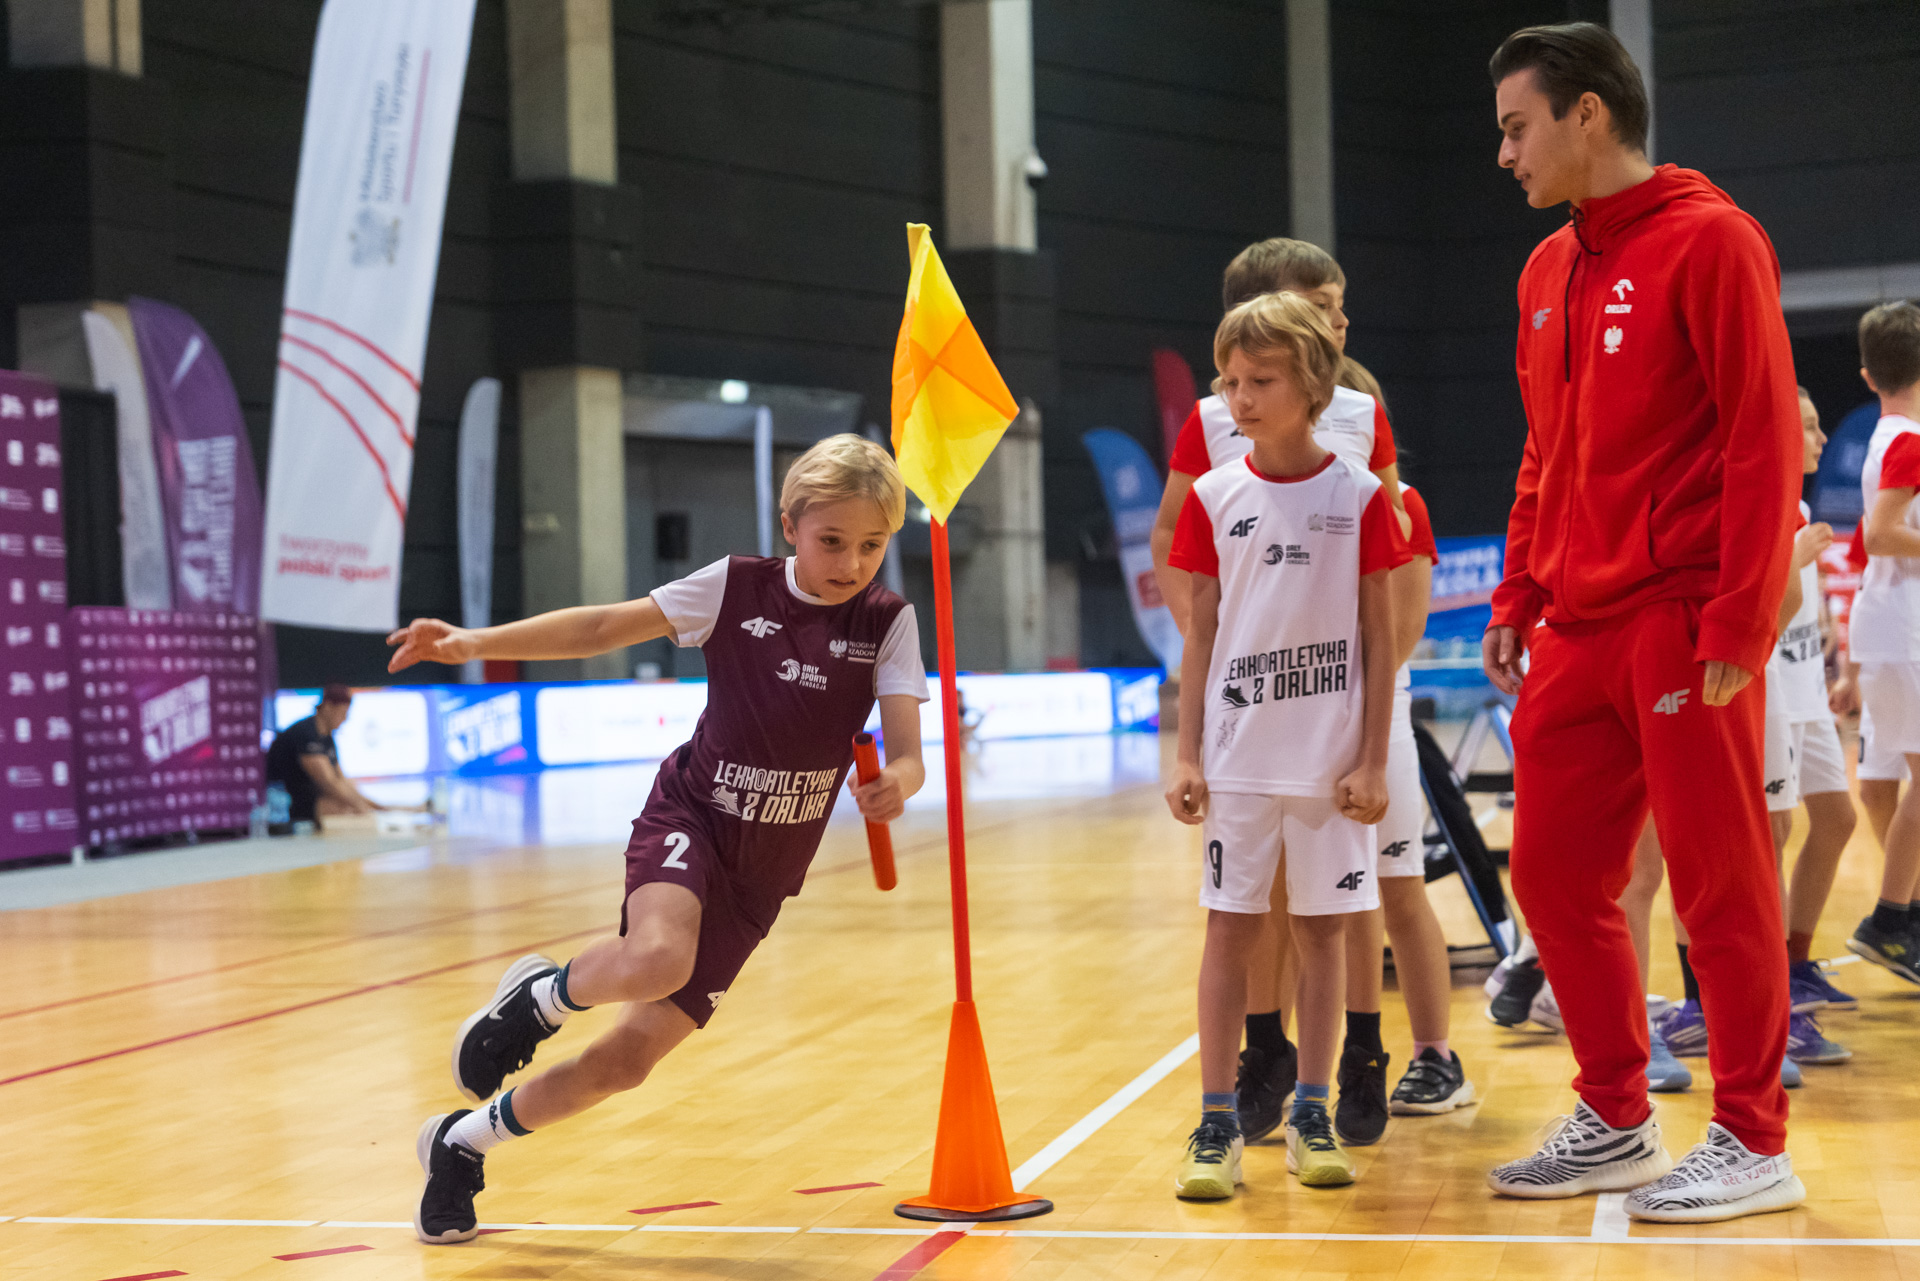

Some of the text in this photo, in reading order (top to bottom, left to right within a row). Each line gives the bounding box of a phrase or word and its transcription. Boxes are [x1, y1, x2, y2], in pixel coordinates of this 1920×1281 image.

[1229, 516, 1259, 537] 4F
[740, 616, 783, 639] 4F
[801, 672, 828, 685] SPORTU
[802, 664, 820, 674] ORŁY
[799, 680, 827, 691] FUNDACJA
[1274, 663, 1348, 701] ORLIKA
[1653, 688, 1690, 715] 4F
[713, 760, 839, 795] LEKKOATLETYKA
[1765, 779, 1786, 795] 4F
[759, 791, 830, 824] ORLIKA
[660, 831, 690, 870] 2
[1381, 840, 1410, 857] 4F
[1209, 839, 1223, 889] 9
[1336, 871, 1365, 891] 4F
